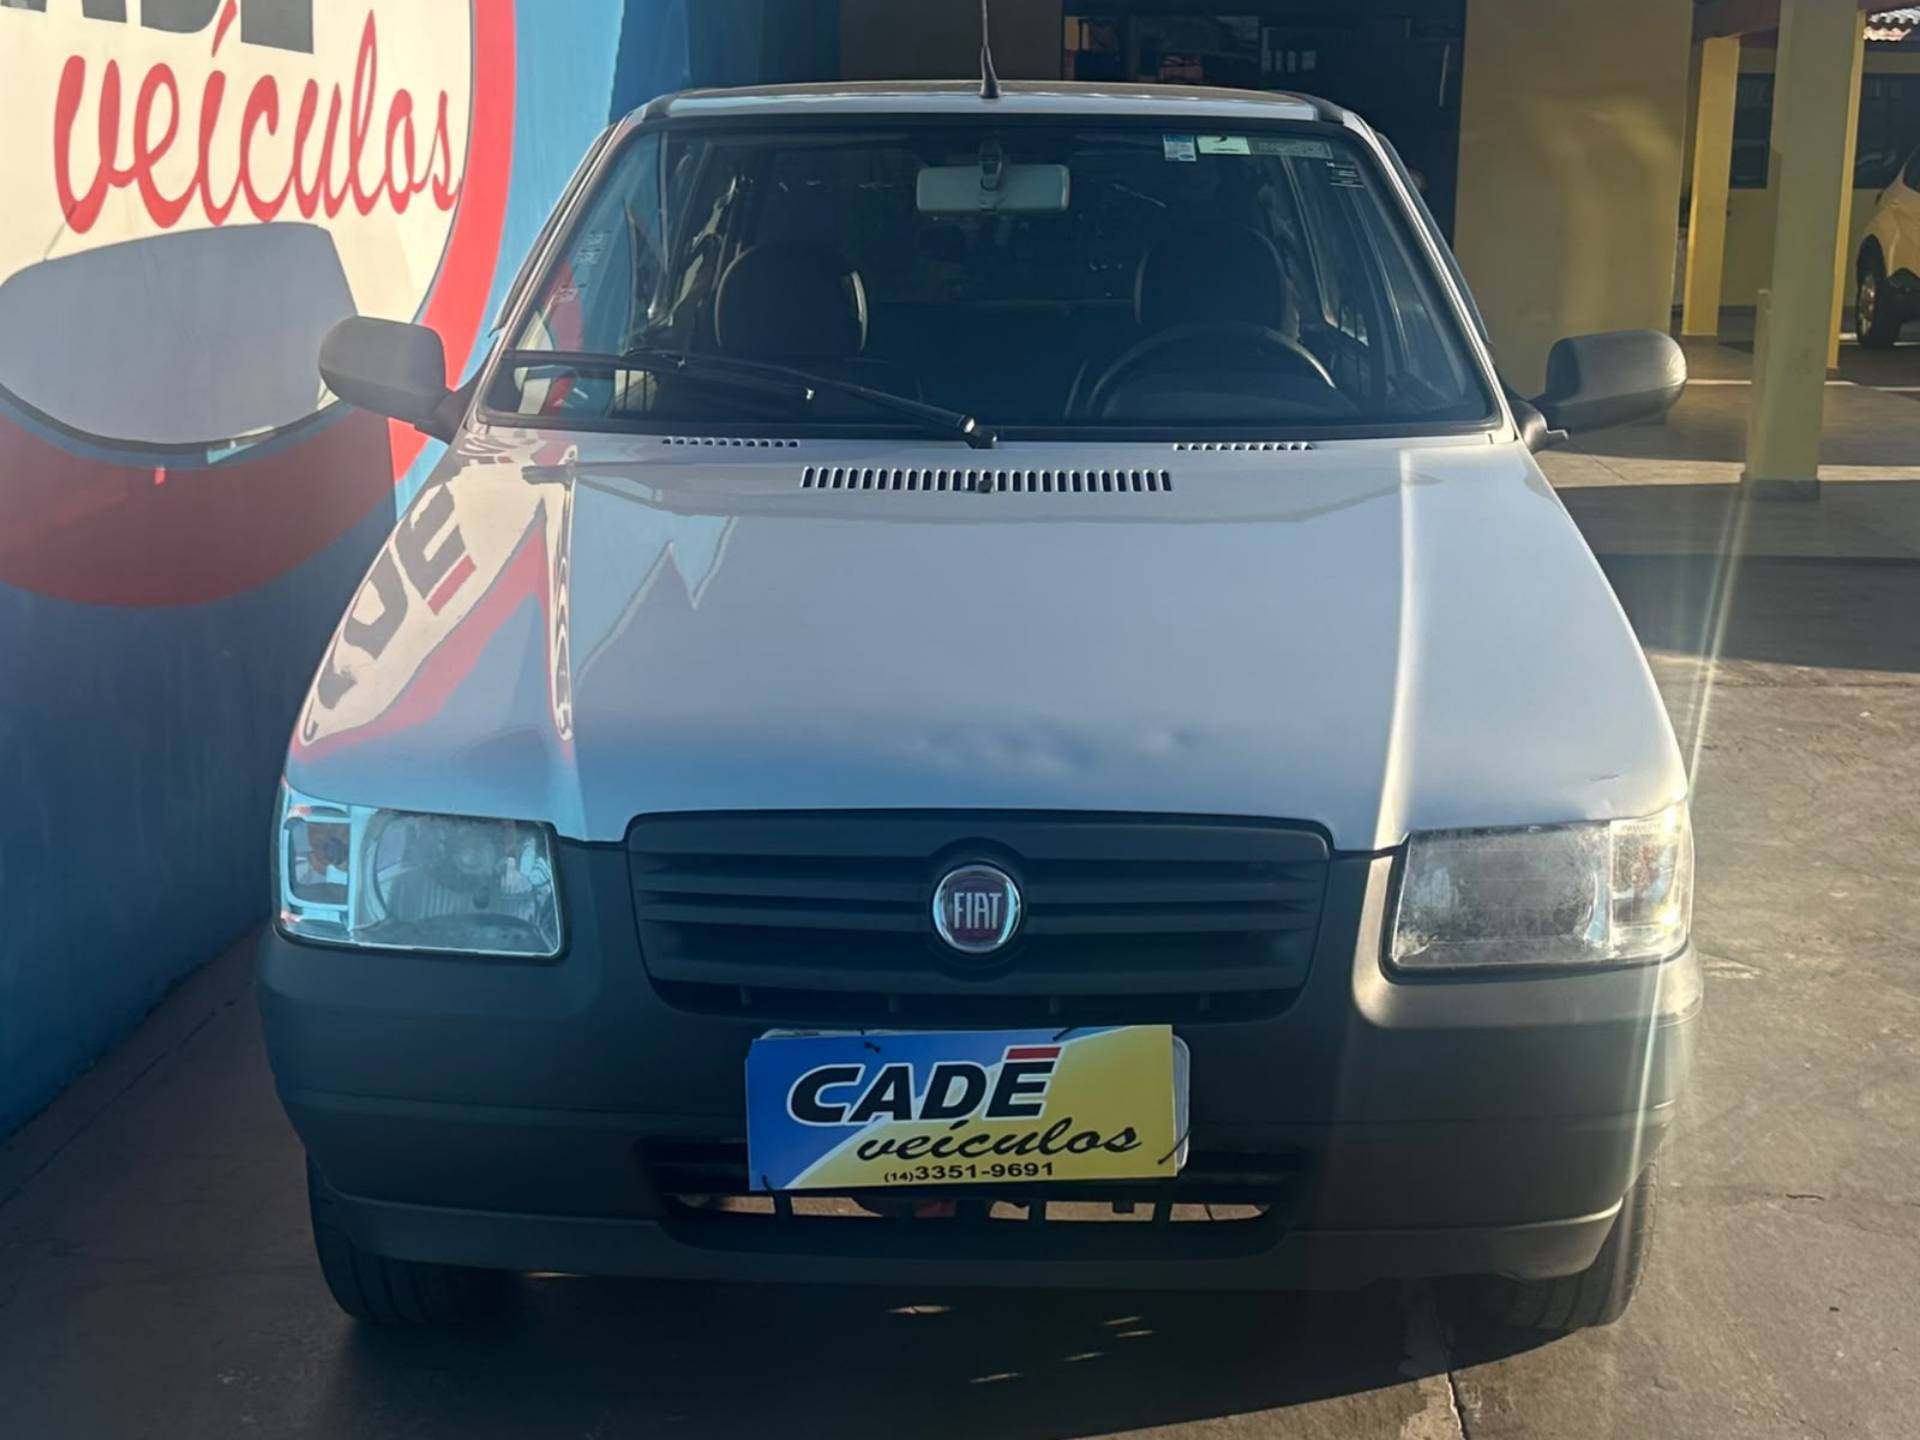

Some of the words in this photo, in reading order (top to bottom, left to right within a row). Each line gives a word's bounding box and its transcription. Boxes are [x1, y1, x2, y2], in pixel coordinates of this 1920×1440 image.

[54, 0, 462, 234] veículos
[953, 891, 1003, 930] FIAT
[788, 1046, 1062, 1124] CADE
[857, 1117, 1142, 1161] veículos
[884, 1162, 1054, 1183] (14)3351-9691
